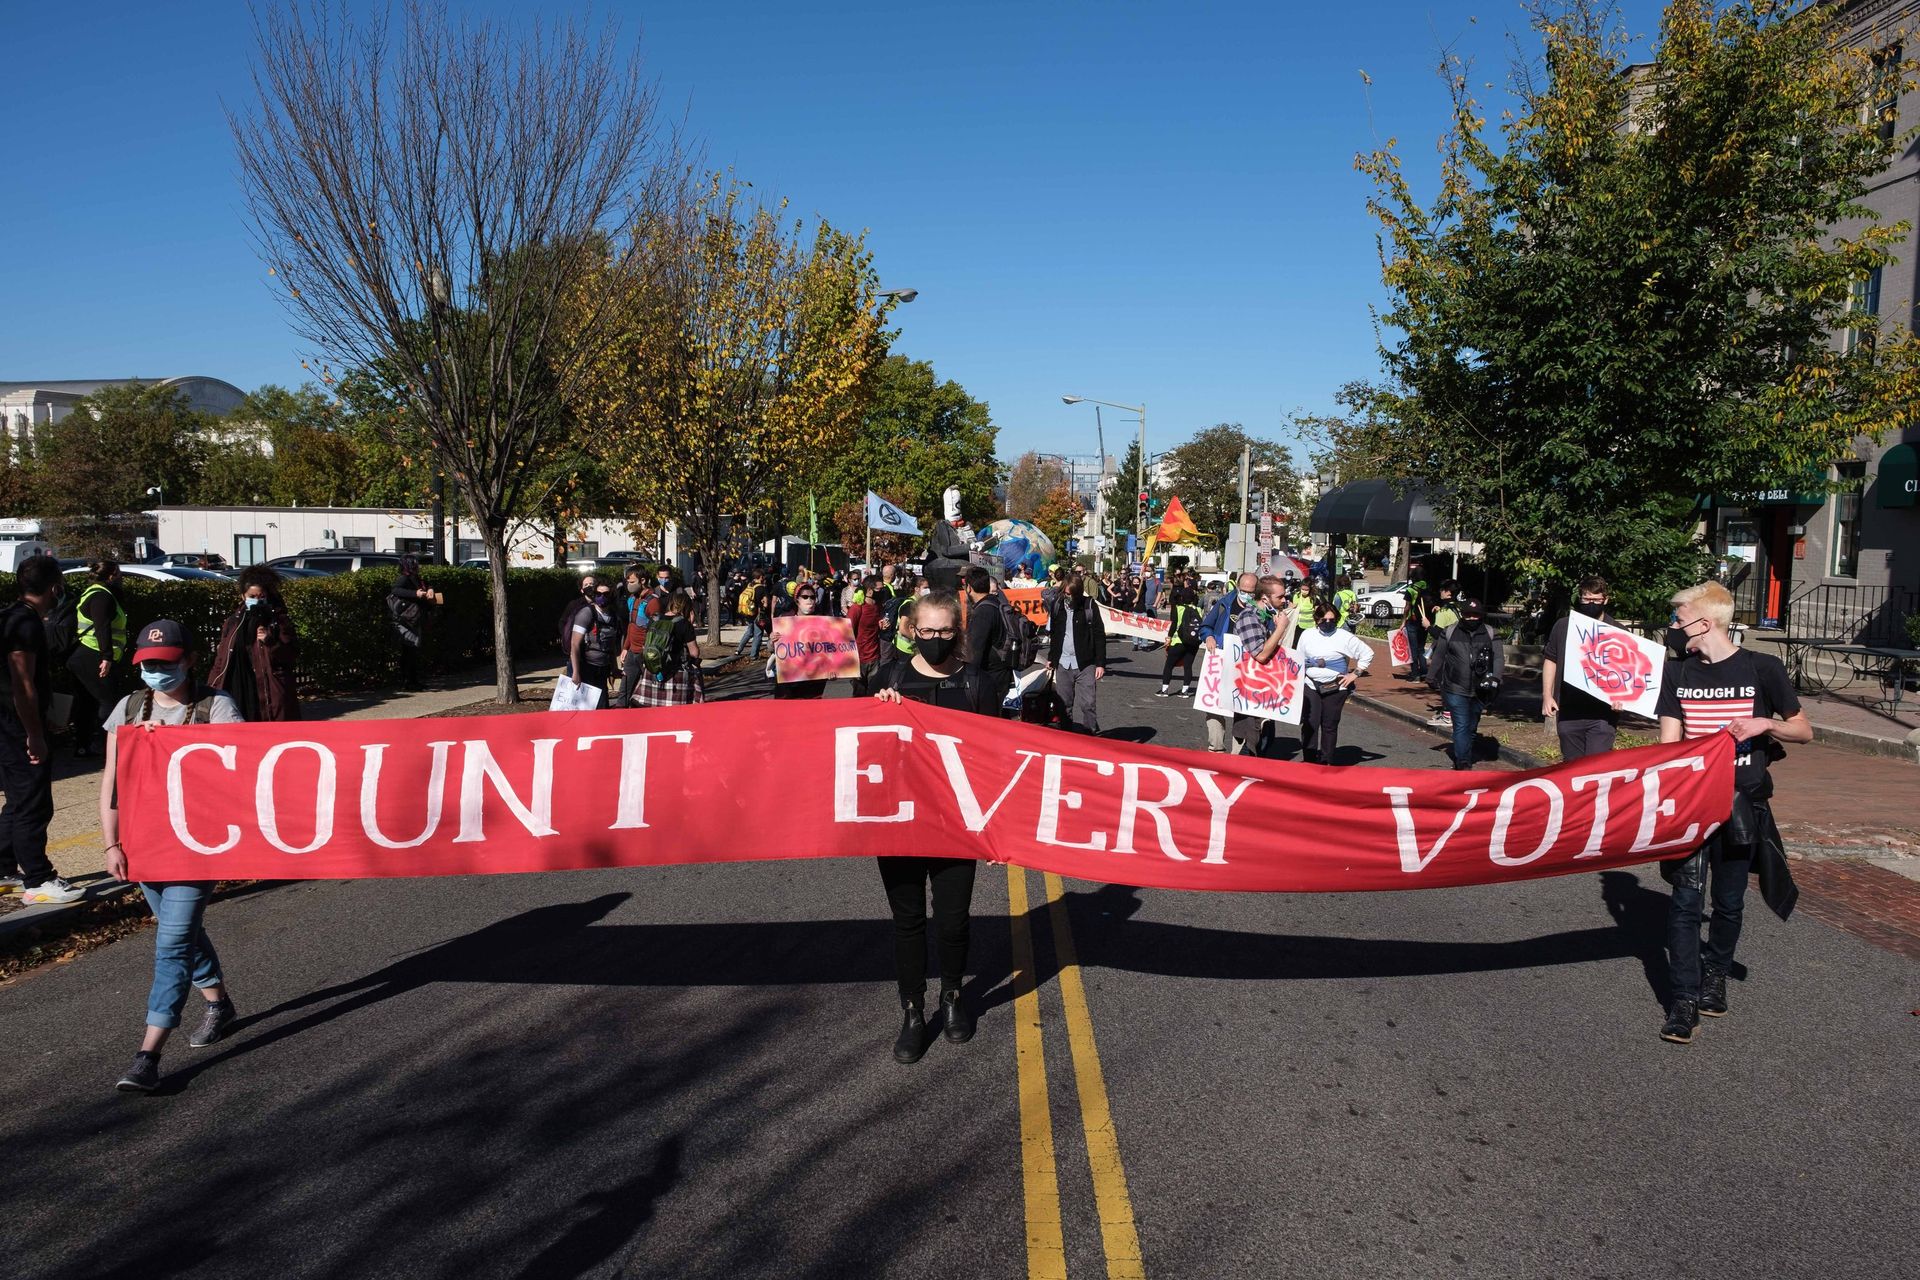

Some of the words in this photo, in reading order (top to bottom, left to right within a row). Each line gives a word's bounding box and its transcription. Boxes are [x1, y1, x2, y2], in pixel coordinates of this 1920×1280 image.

[1767, 490, 1788, 500] DELI
[1009, 600, 1046, 617] STE
[147, 628, 163, 643] DC
[1576, 621, 1611, 646] WE
[776, 642, 805, 660] OUR
[808, 641, 836, 654] VOTES
[838, 640, 857, 653] COUNT
[1585, 650, 1611, 664] THE
[1583, 666, 1658, 691] PEOPLE
[1232, 688, 1290, 715] RISING
[1676, 686, 1735, 699] ENOUGH
[1739, 686, 1756, 697] IS
[166, 729, 694, 855] COUNT
[833, 725, 1264, 865] EVERY
[1382, 755, 1721, 874] VOTE.
